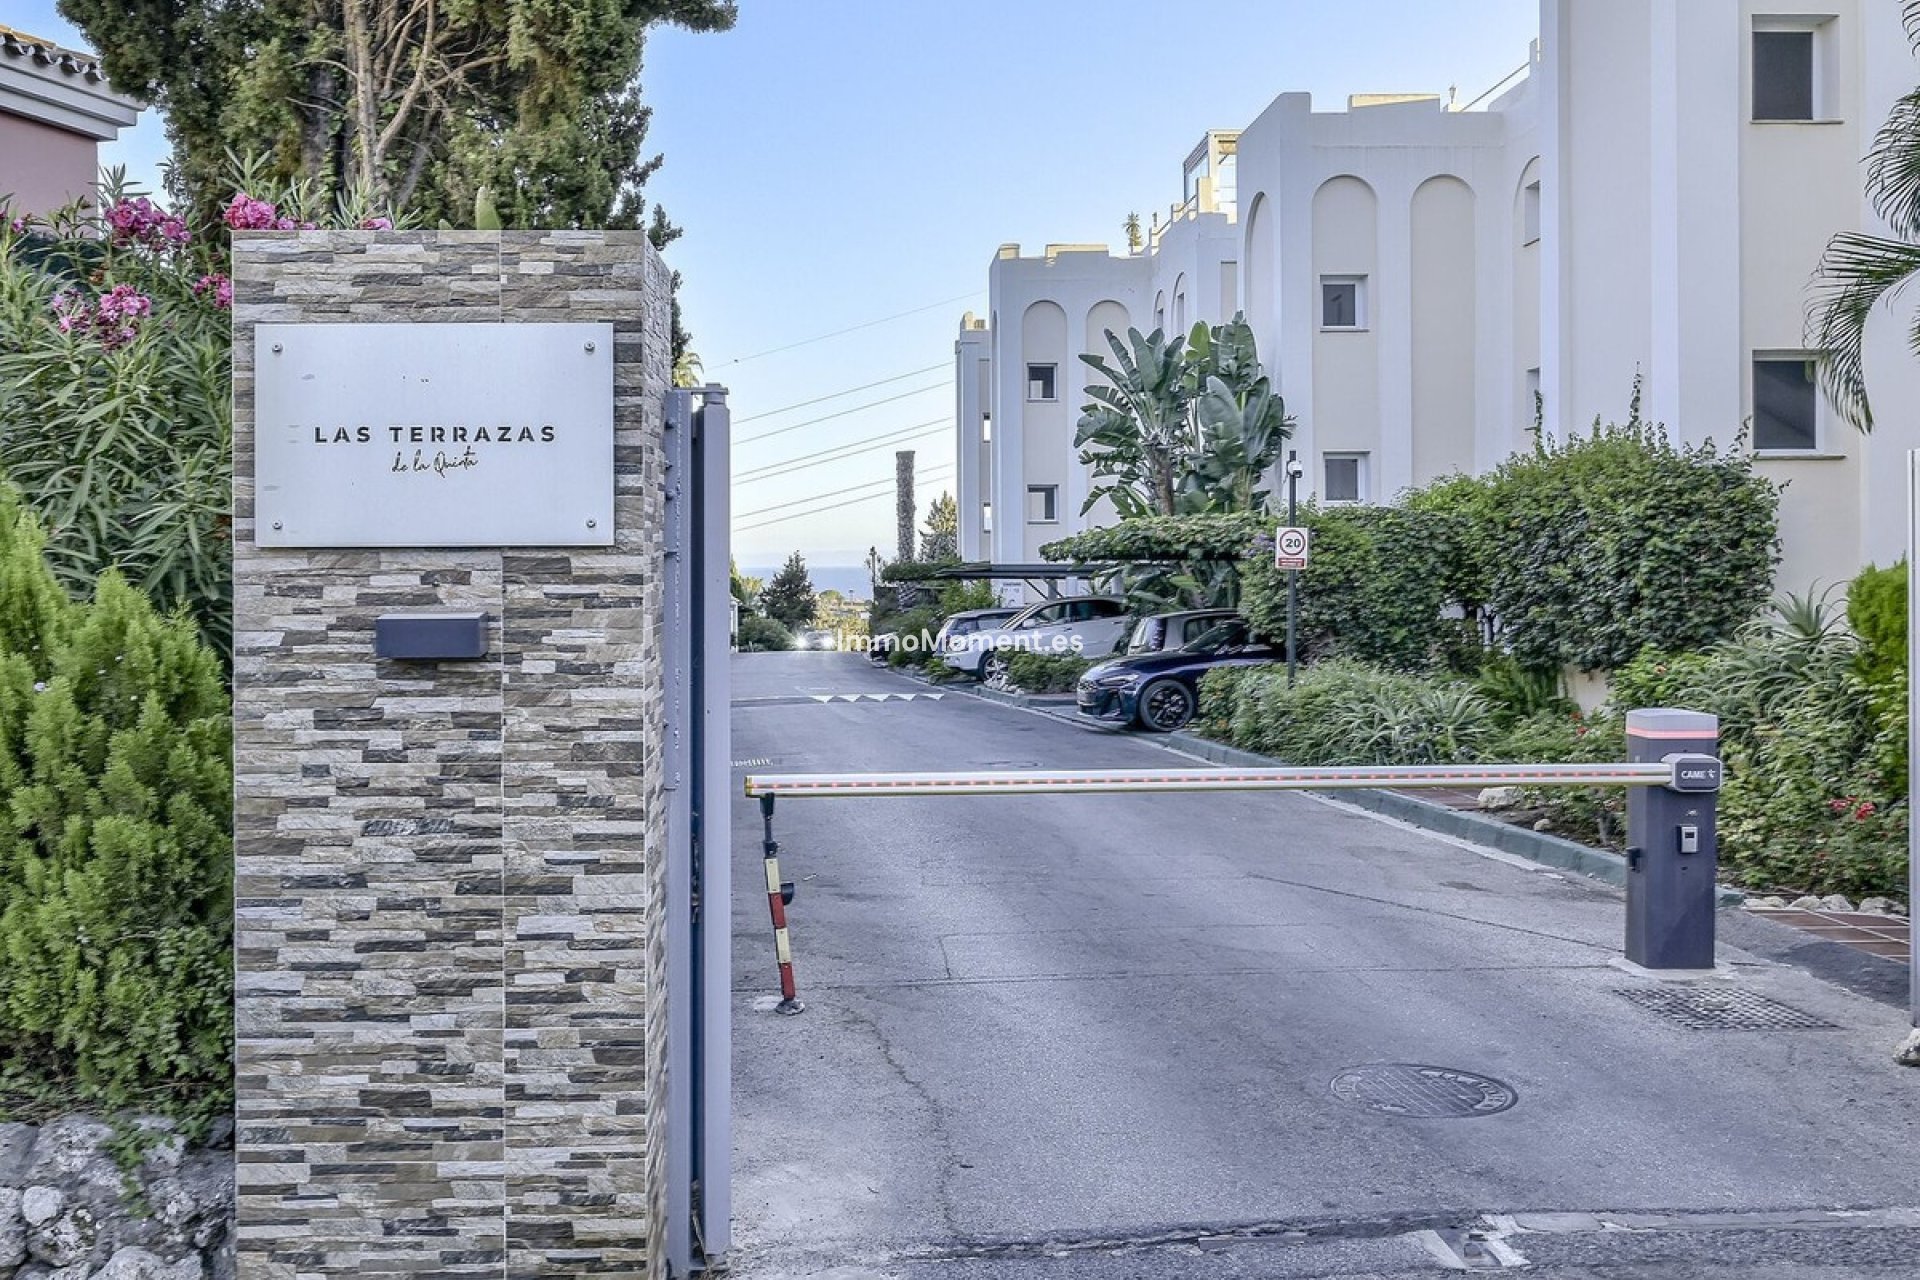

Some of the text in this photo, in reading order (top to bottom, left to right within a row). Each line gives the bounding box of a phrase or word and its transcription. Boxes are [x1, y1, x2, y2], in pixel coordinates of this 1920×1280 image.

[314, 426, 556, 444] LAS TERRAZAS
[391, 445, 479, 479] de la Quinta
[1285, 538, 1302, 548] 20
[1681, 770, 1707, 780] CAME
